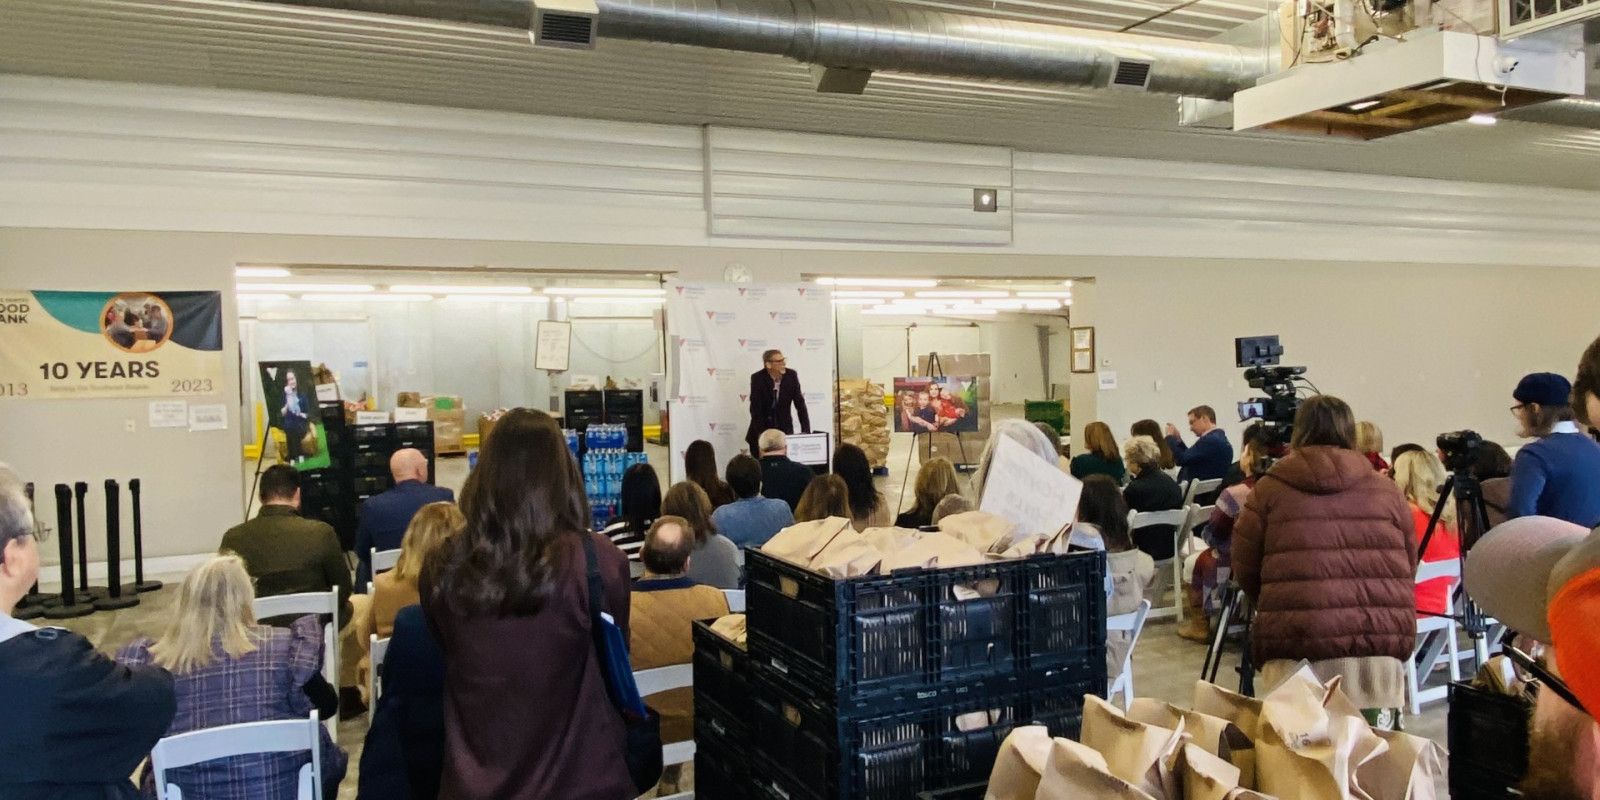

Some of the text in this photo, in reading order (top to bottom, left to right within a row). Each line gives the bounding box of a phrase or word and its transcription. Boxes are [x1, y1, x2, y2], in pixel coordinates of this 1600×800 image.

[39, 360, 160, 380] 10 YEARS
[171, 379, 213, 393] 2023
